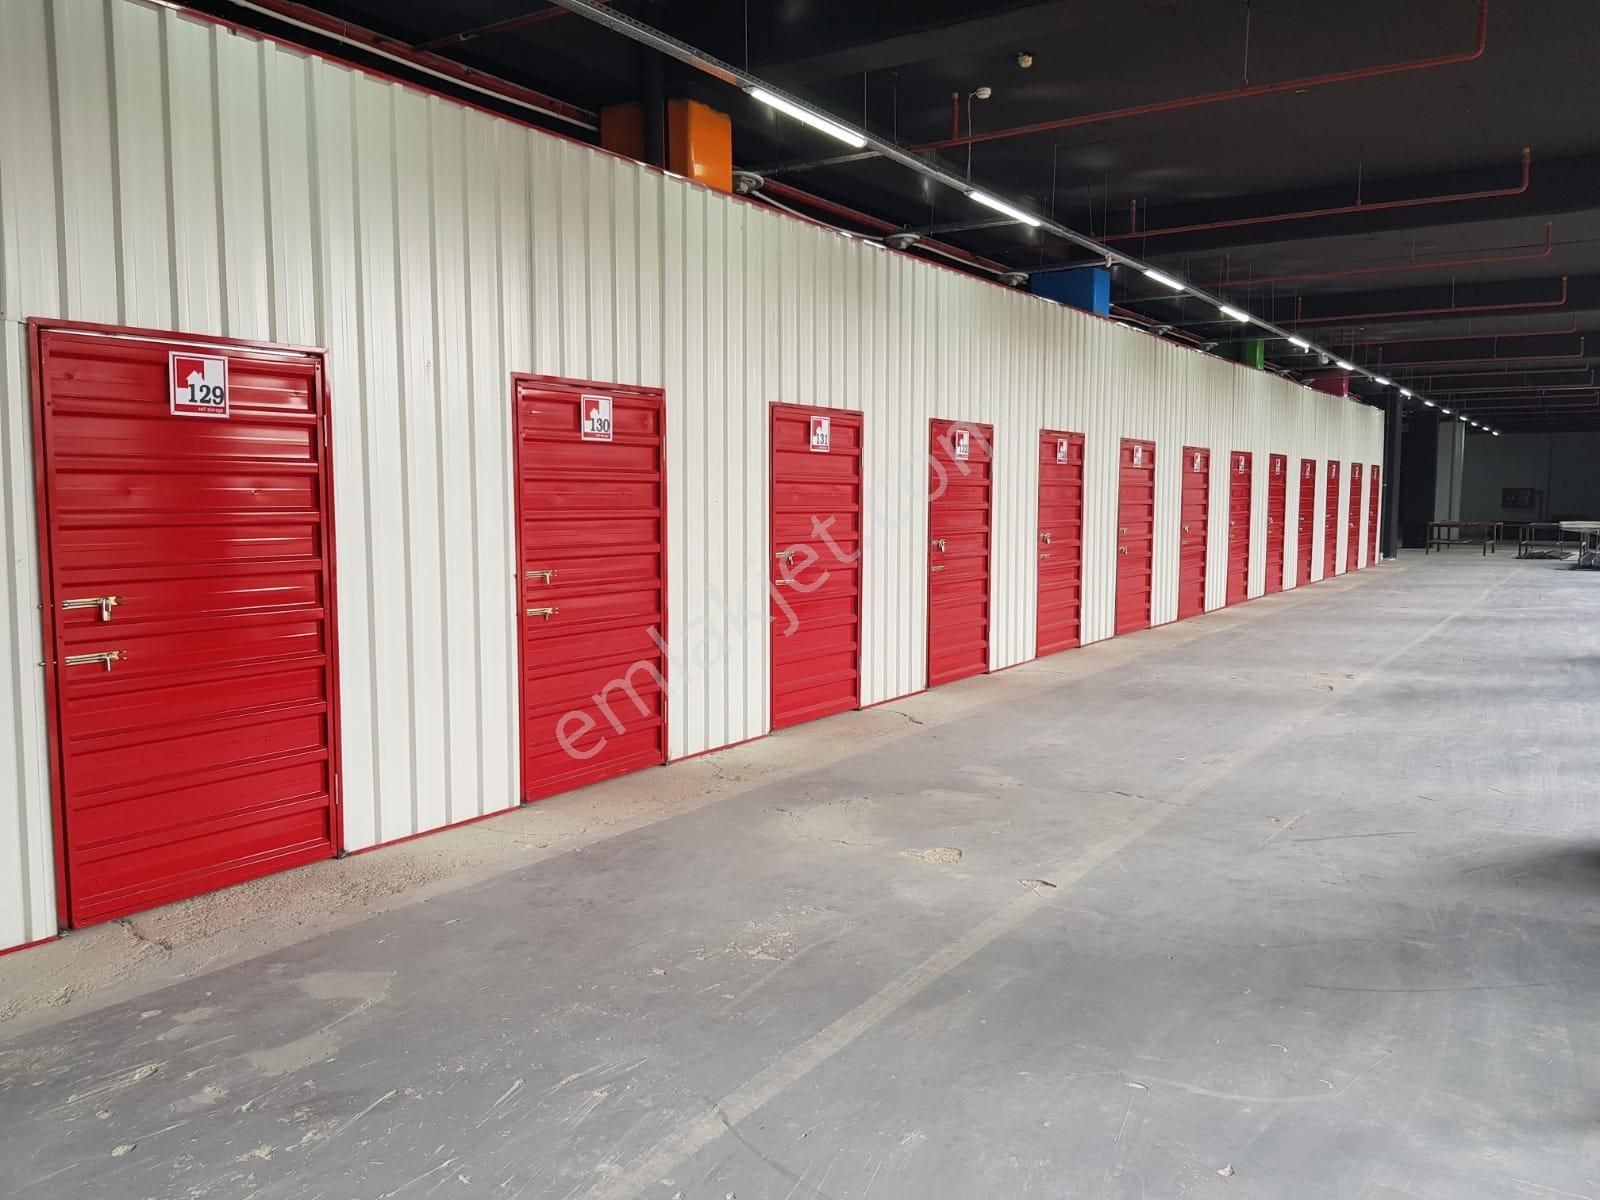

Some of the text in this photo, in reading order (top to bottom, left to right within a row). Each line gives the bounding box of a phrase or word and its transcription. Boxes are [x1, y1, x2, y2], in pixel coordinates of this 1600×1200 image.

[188, 383, 224, 405] 129
[590, 418, 610, 432] 130
[816, 433, 828, 445] 131
